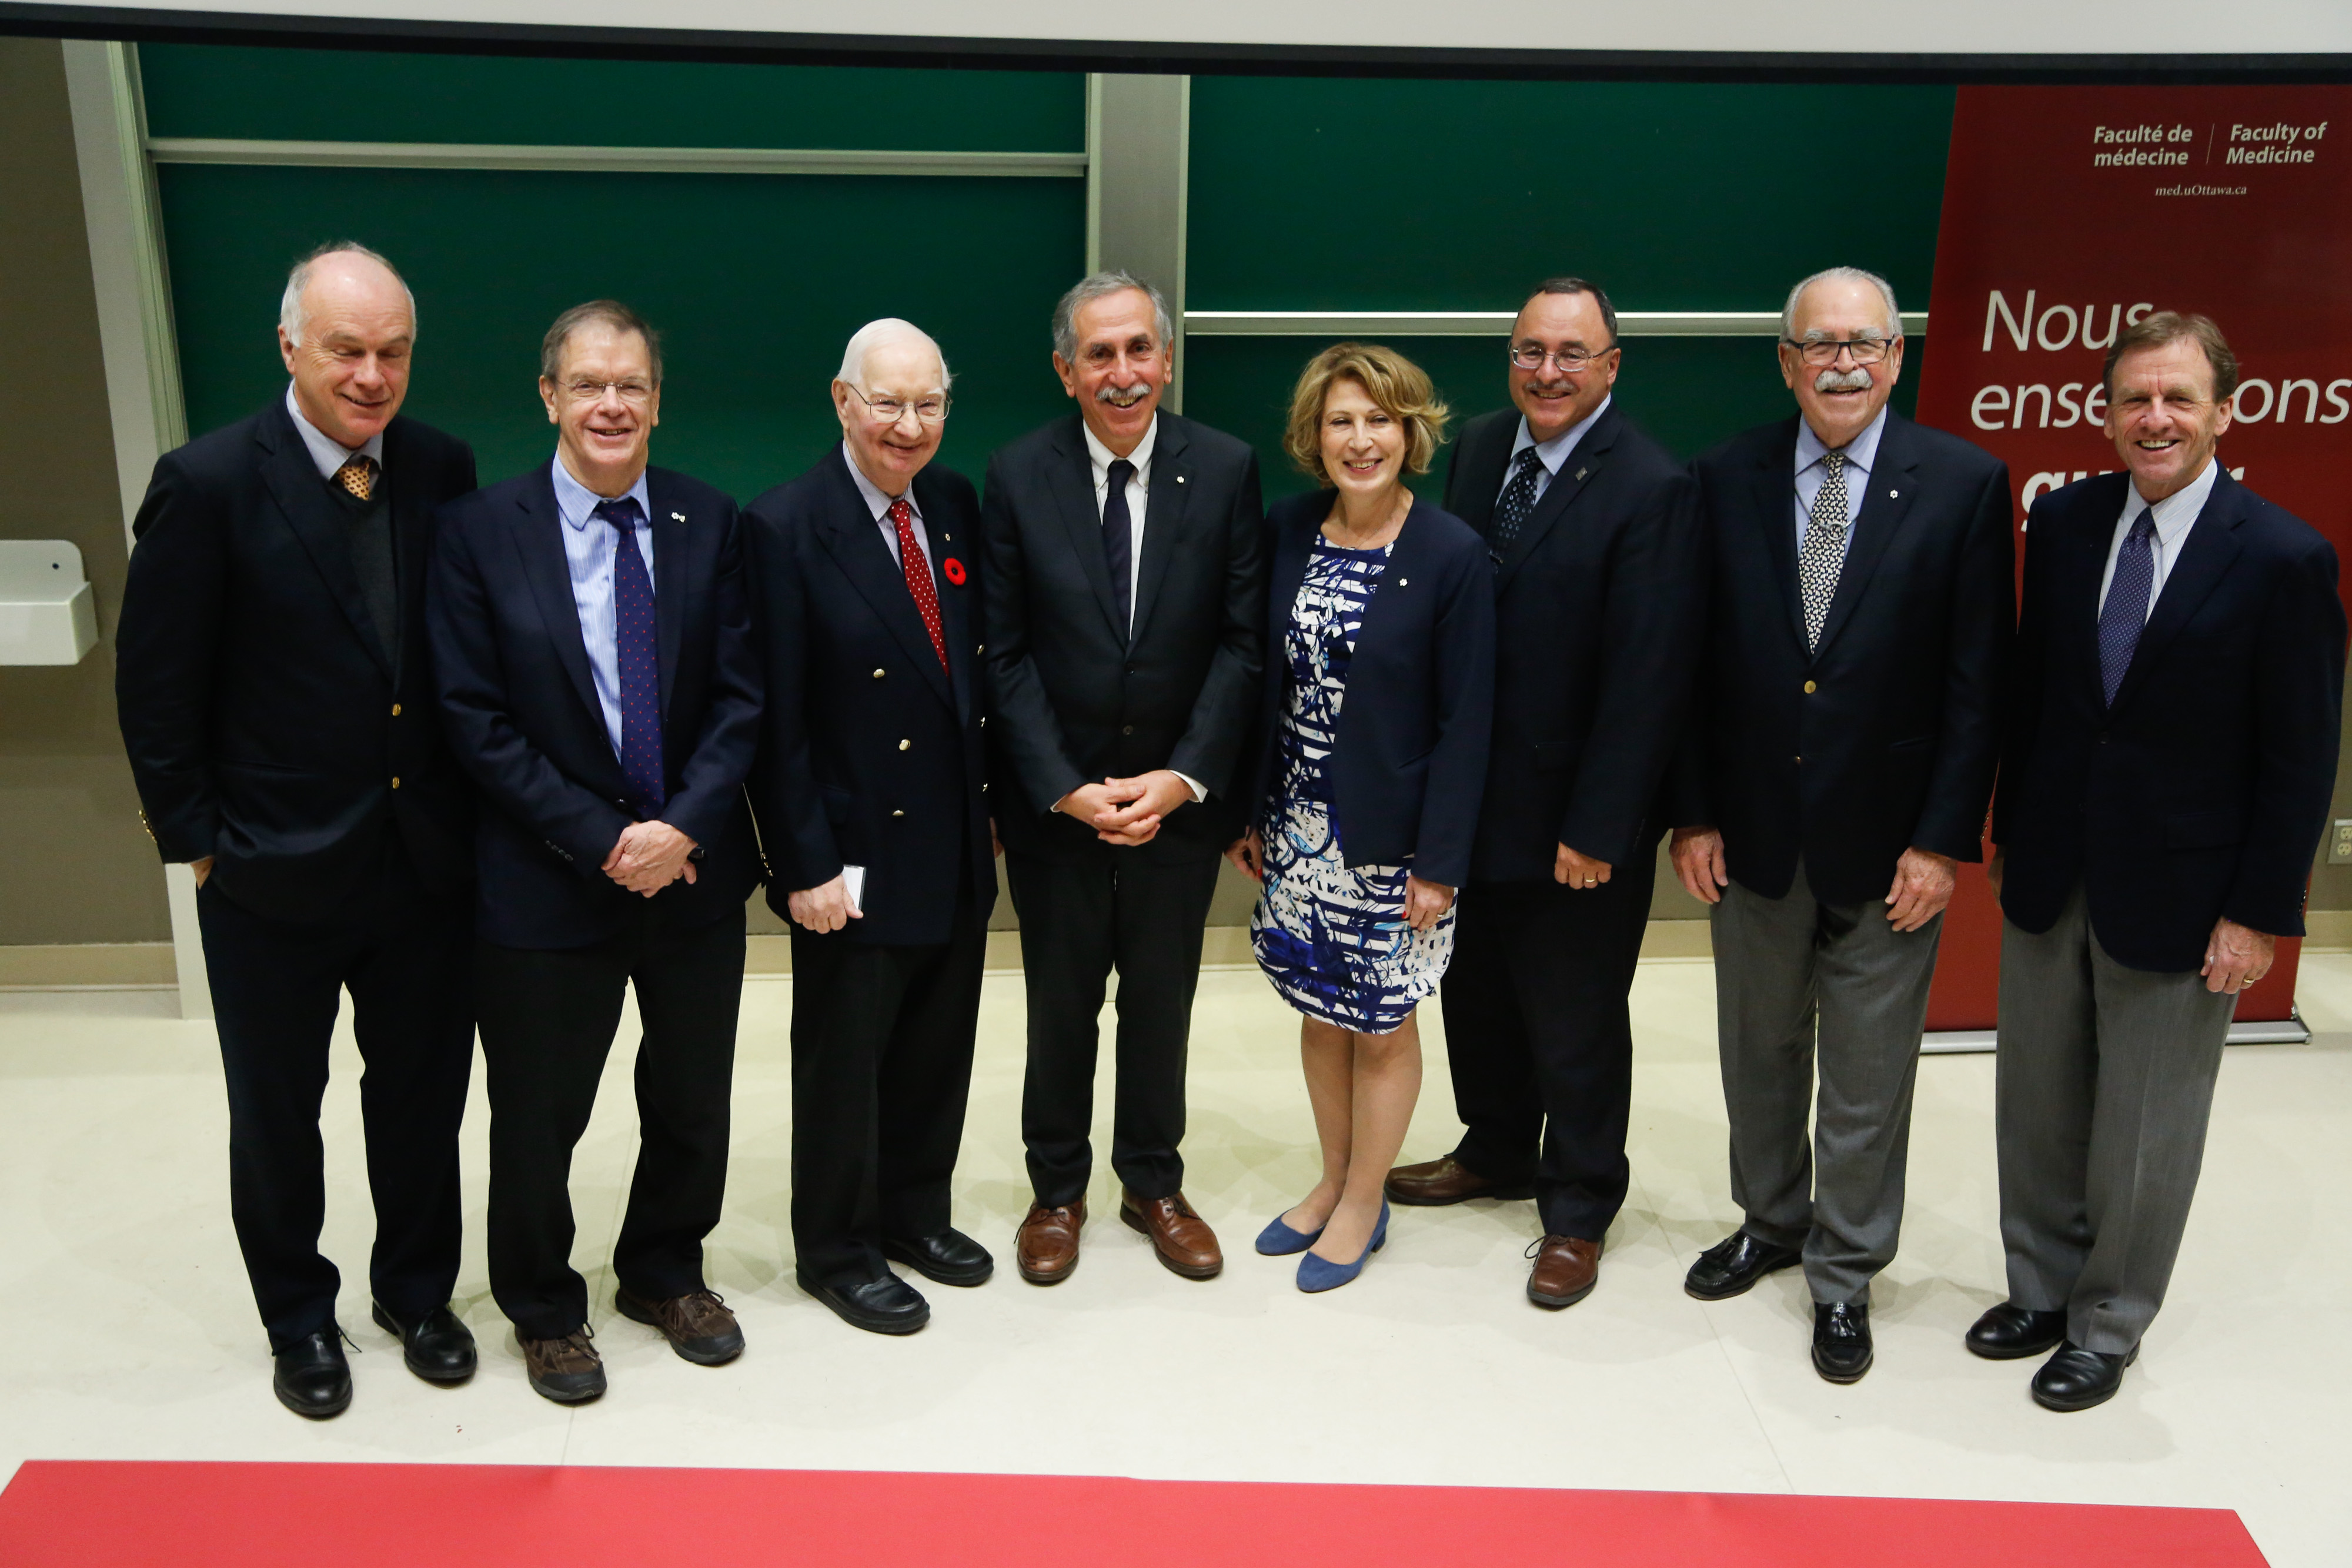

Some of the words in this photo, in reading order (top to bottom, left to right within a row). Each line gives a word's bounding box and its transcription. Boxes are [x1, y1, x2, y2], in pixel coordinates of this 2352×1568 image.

[2094, 125, 2163, 143] Faculté
[2167, 124, 2193, 142] de
[2230, 122, 2300, 145] Faculty
[2304, 121, 2328, 140] of
[2094, 148, 2189, 166] médecine
[2226, 143, 2315, 165] Medicine
[2155, 184, 2247, 196] med.uOttawa.ca
[1970, 378, 2352, 431] enseons
